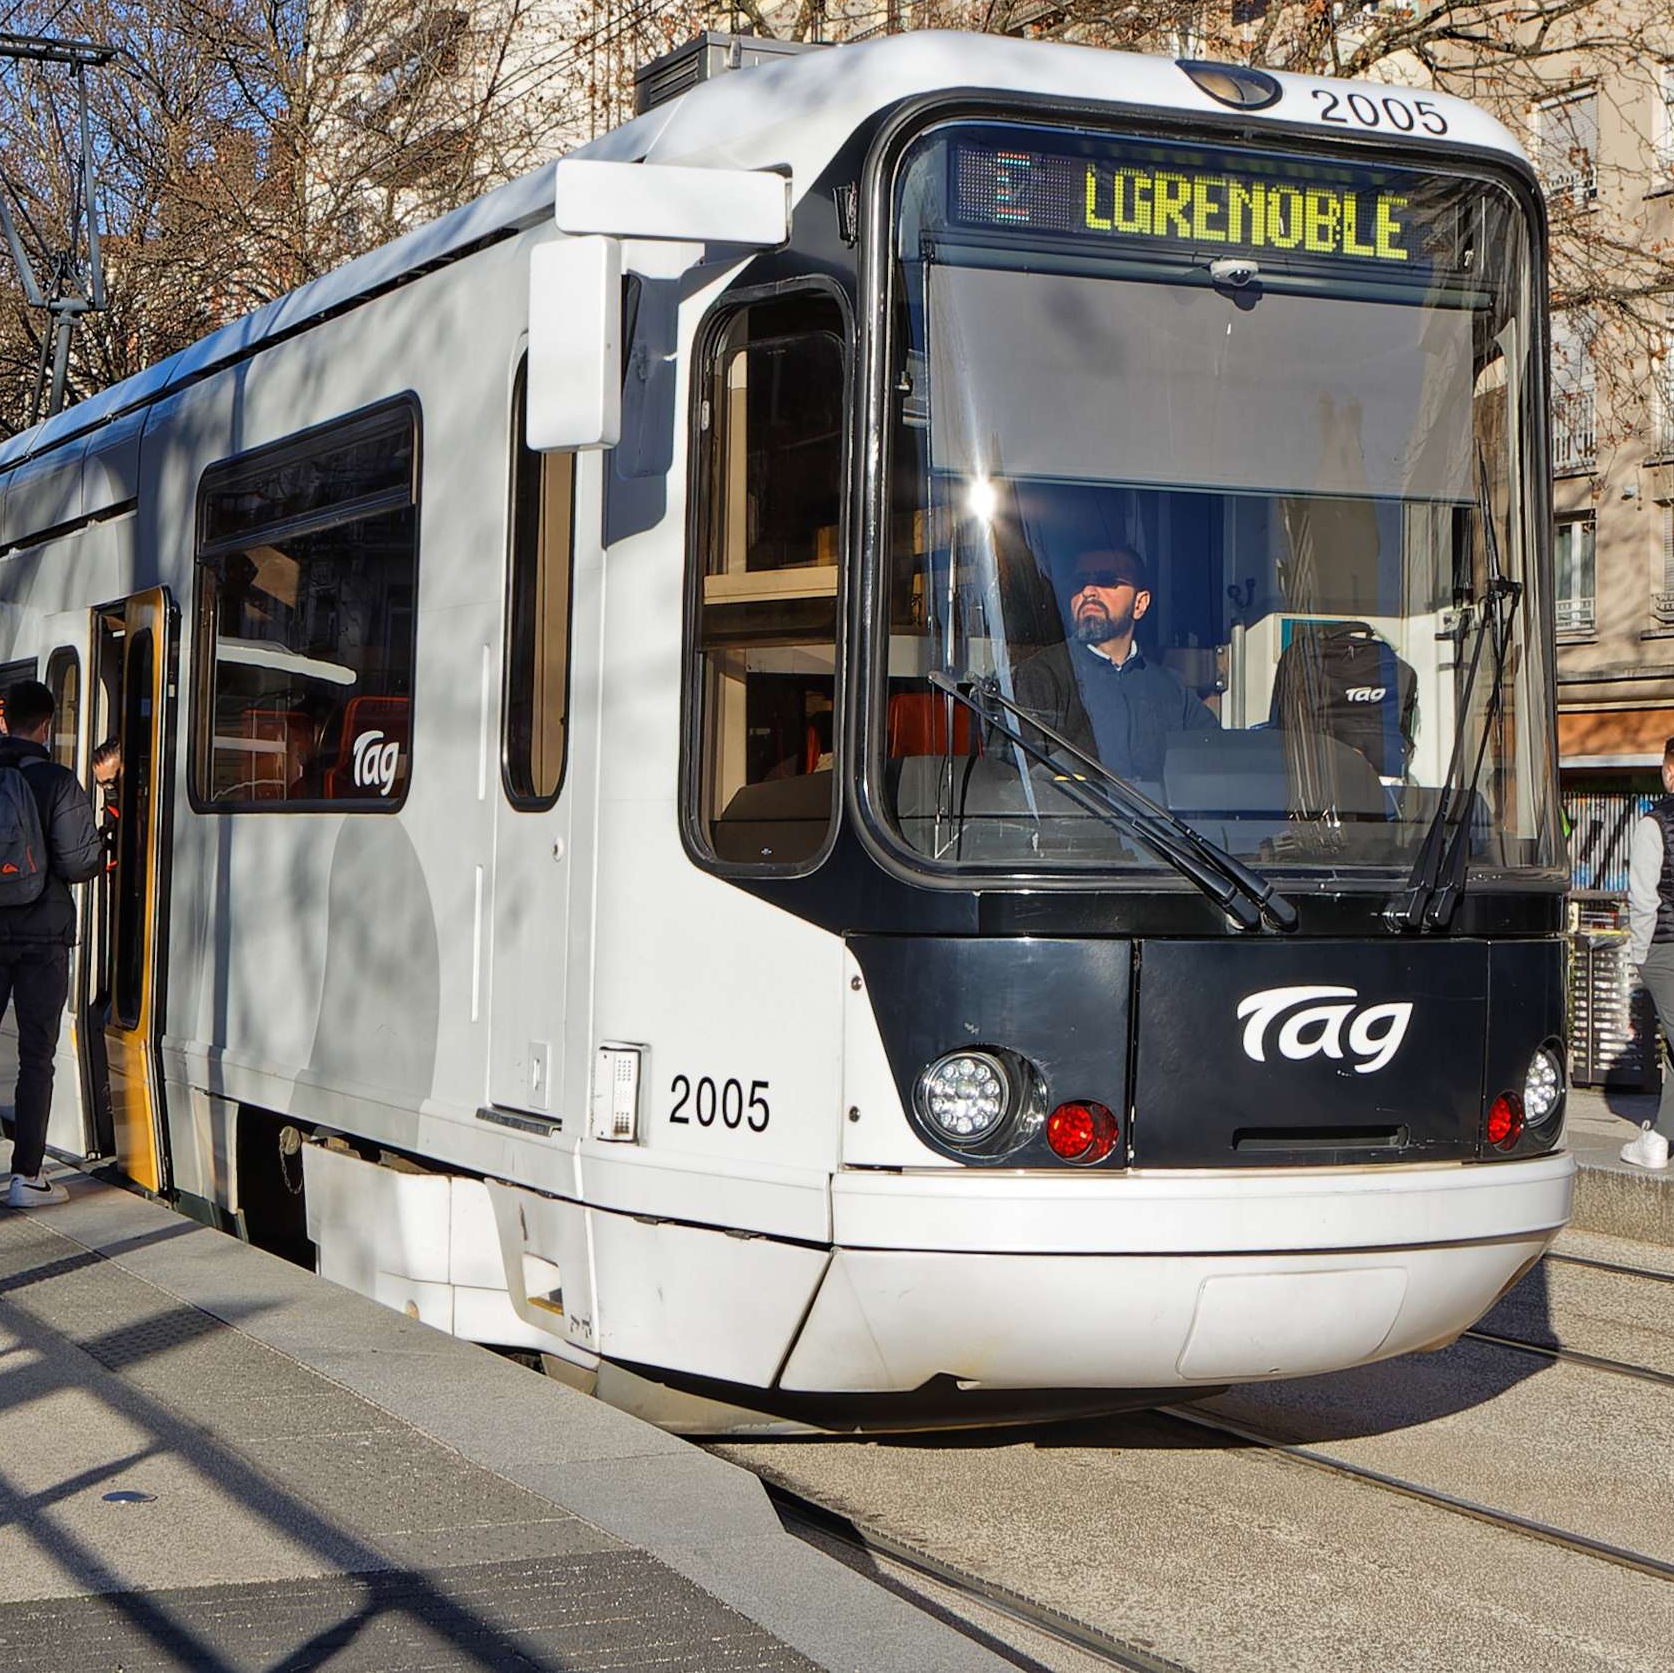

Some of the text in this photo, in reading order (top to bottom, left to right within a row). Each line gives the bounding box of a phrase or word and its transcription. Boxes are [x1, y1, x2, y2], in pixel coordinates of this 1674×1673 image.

[1311, 89, 1448, 135] 2005
[353, 730, 400, 796] Tag
[1237, 985, 1414, 1074] Tag
[669, 1074, 770, 1133] 2005
